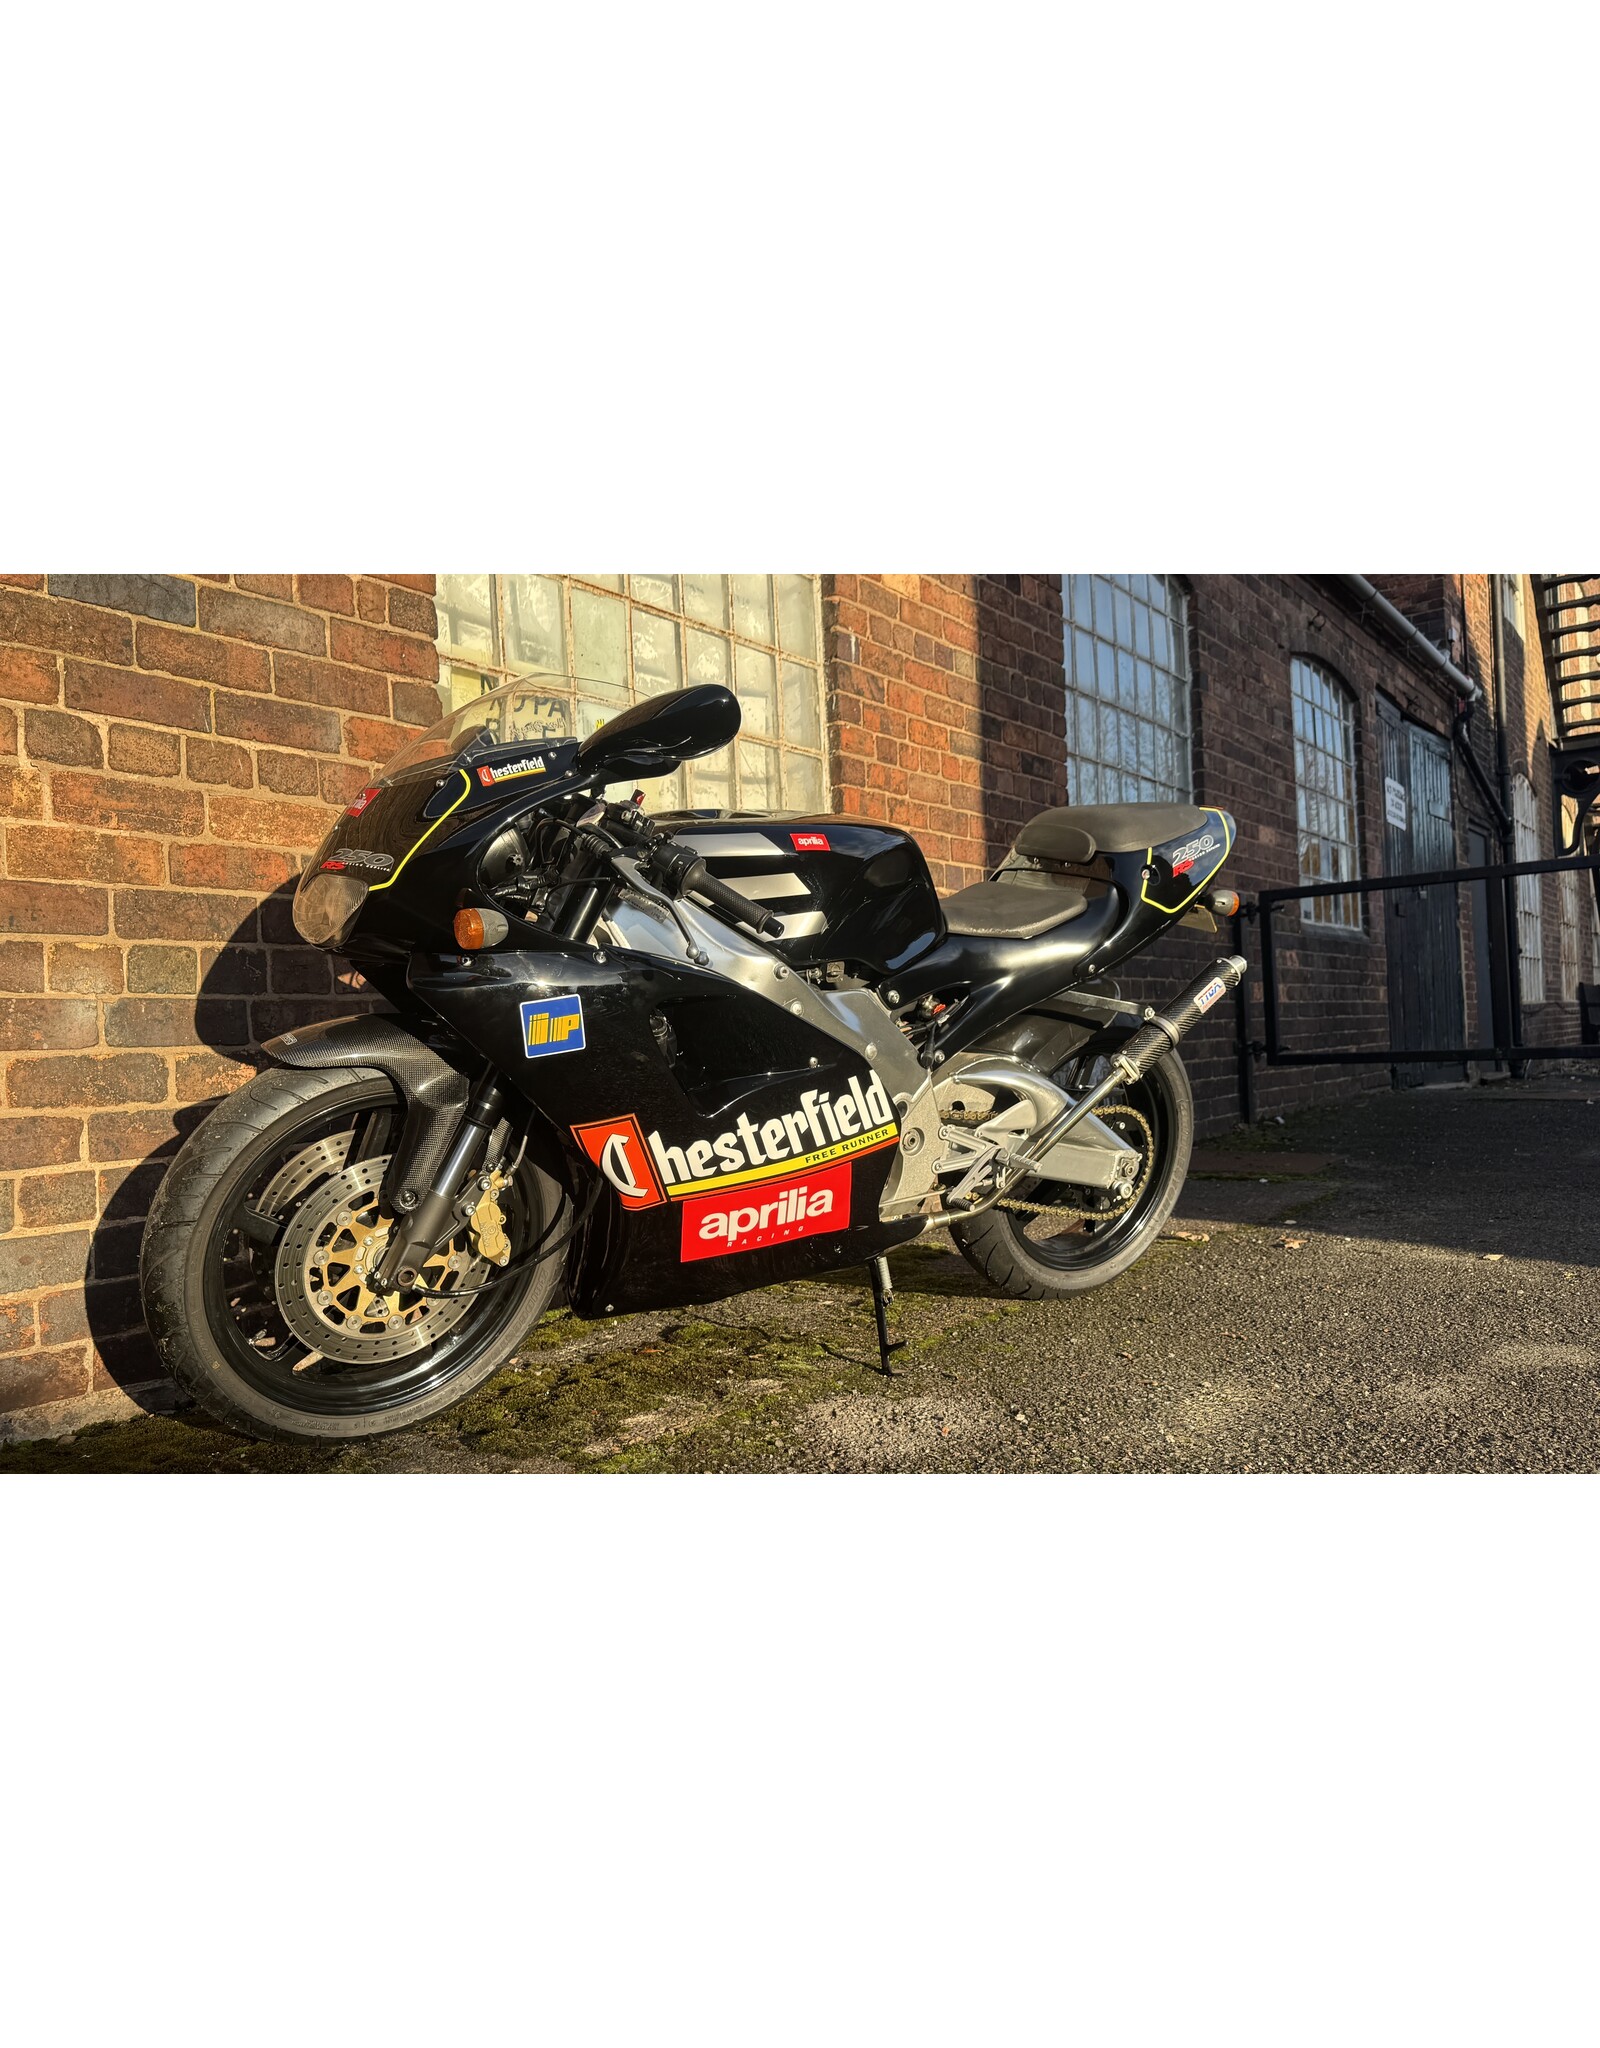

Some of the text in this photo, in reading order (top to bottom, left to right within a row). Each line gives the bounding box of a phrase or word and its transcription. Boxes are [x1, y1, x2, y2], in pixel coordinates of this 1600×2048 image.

[481, 756, 545, 782] Chesterfield
[797, 836, 825, 847] aprilia
[1172, 834, 1214, 868] 250
[320, 860, 347, 871] RS
[328, 848, 395, 867] 250
[1172, 859, 1195, 878] RS
[600, 1069, 894, 1199] Chesterfield
[805, 1128, 890, 1164] FREE RUNNER
[698, 1185, 834, 1242] aprilia
[727, 1225, 804, 1248] RACING
